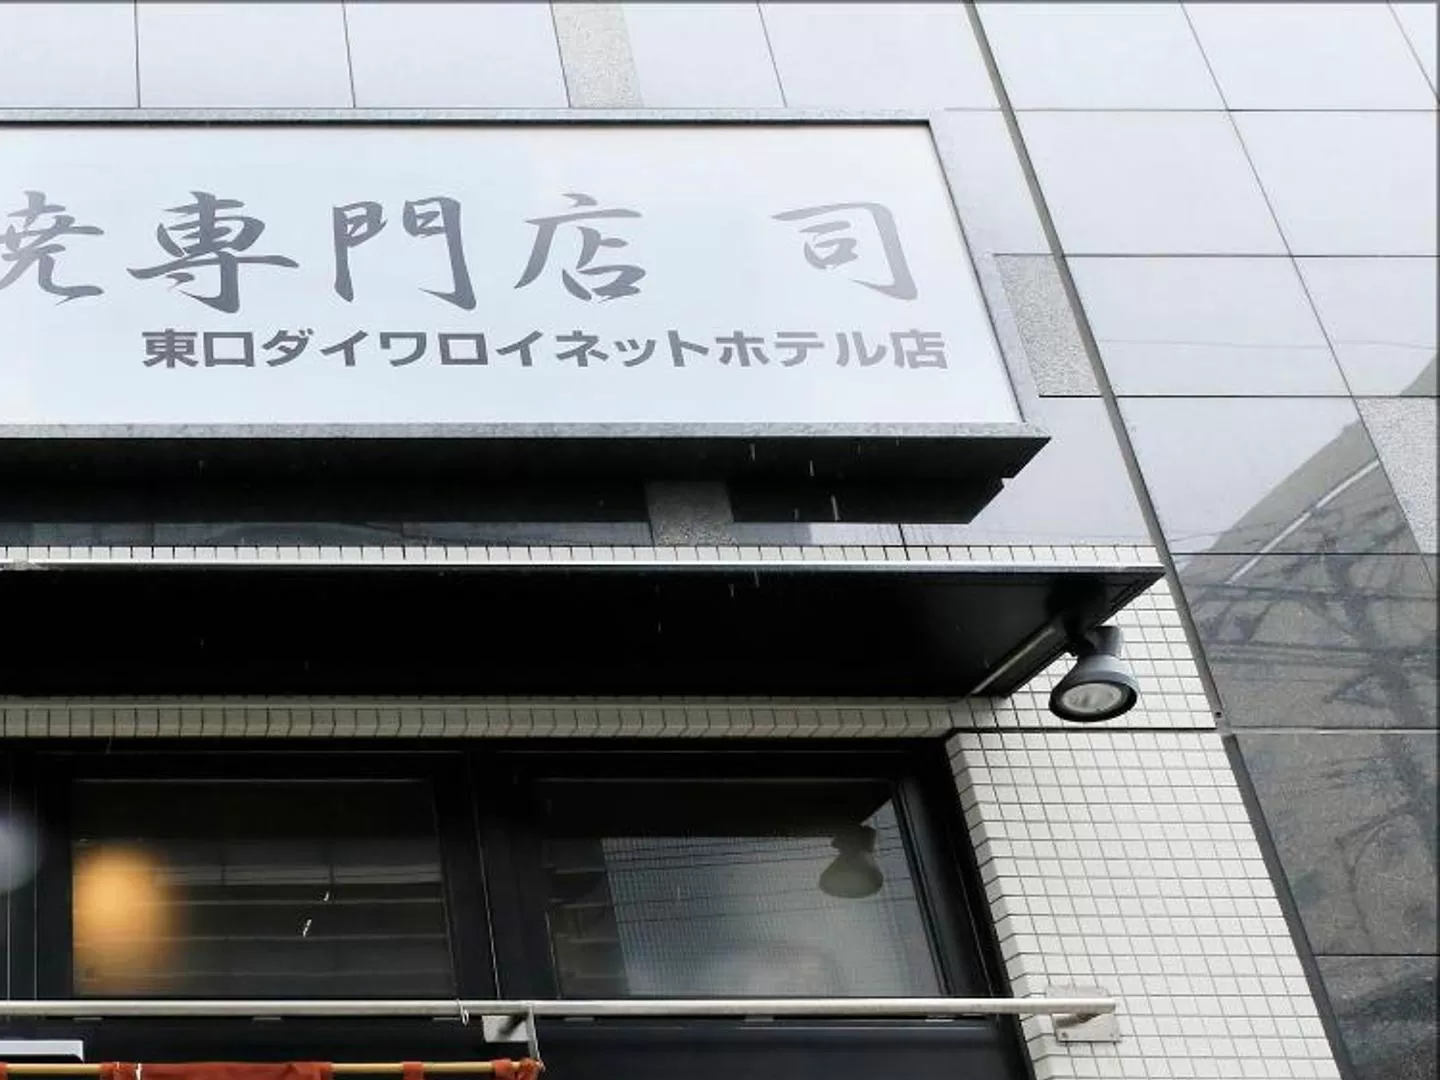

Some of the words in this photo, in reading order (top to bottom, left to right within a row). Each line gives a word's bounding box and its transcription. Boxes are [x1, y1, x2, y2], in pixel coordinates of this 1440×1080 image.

[772, 199, 920, 301] 司
[141, 327, 949, 370] 東口ダイワロイネットホテル店
